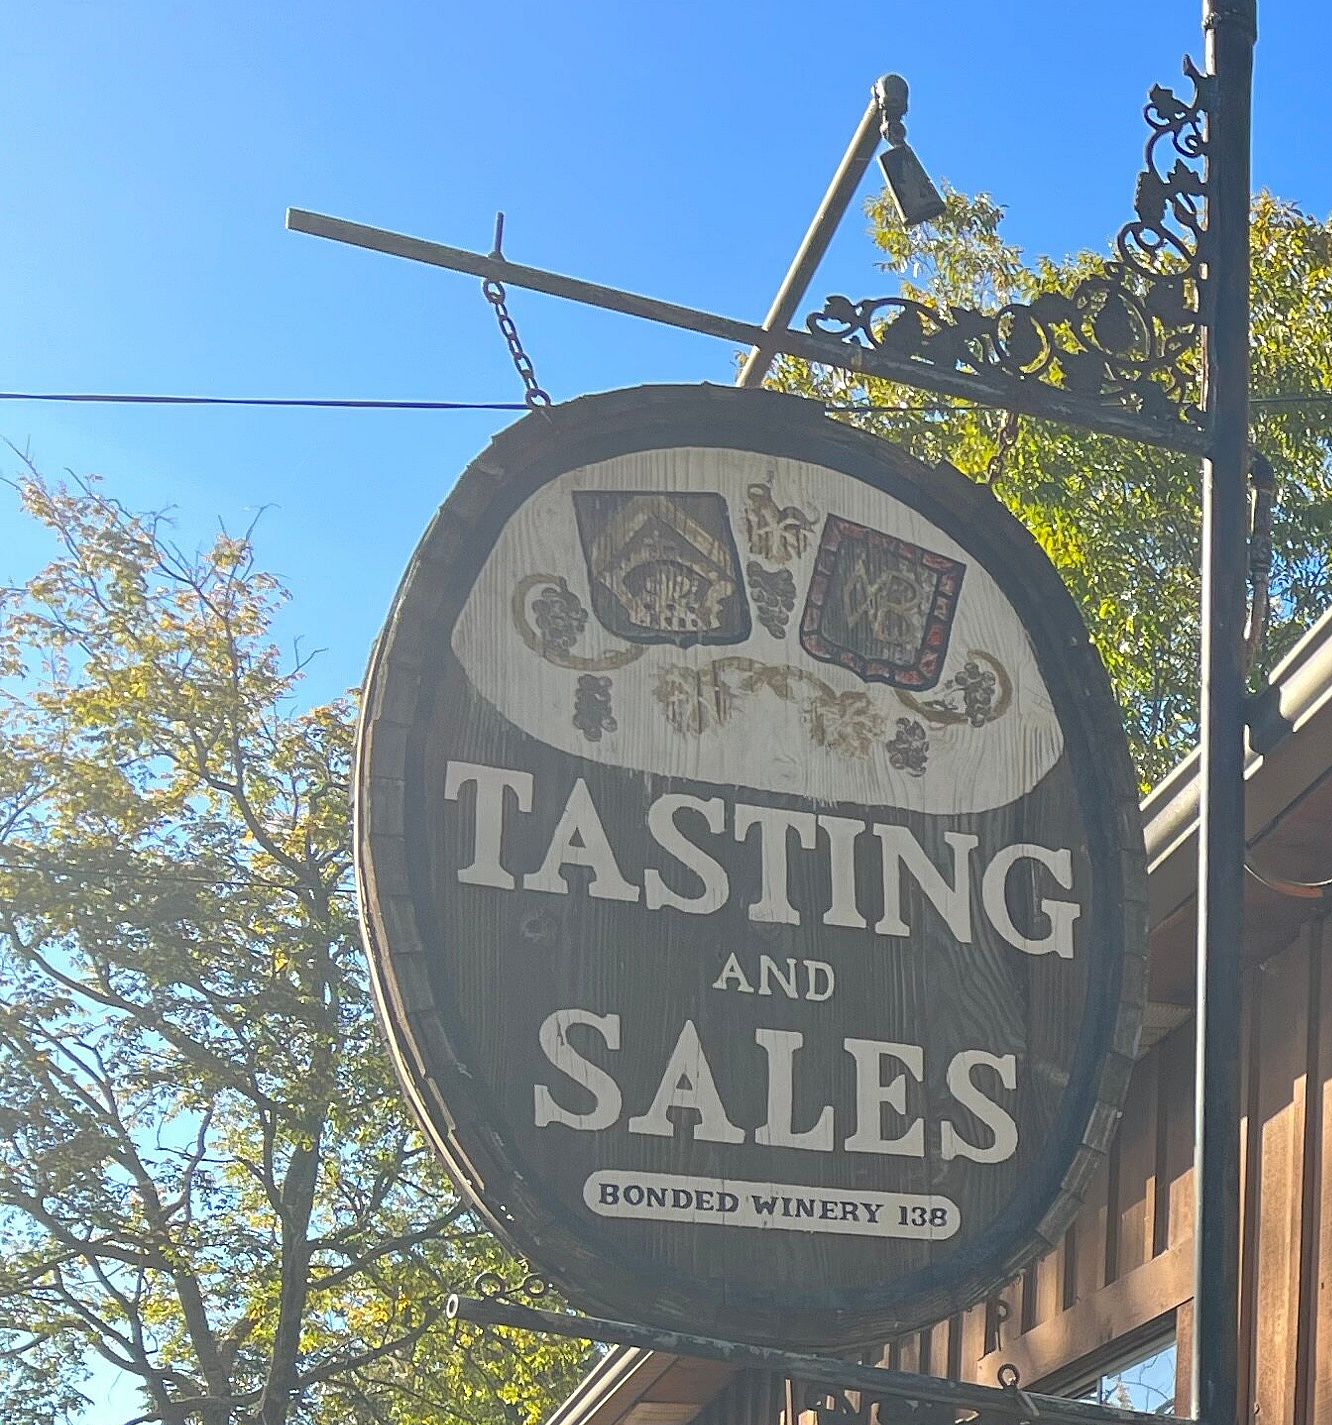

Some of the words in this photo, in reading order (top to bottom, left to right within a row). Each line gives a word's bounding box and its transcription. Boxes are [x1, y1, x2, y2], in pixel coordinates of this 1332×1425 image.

[444, 760, 1082, 959] TASTING
[711, 952, 836, 1000] AND
[533, 1007, 1019, 1163] SALES
[598, 1182, 739, 1215] BONDED
[751, 1194, 884, 1224] WINERY
[898, 1205, 948, 1228] 138
